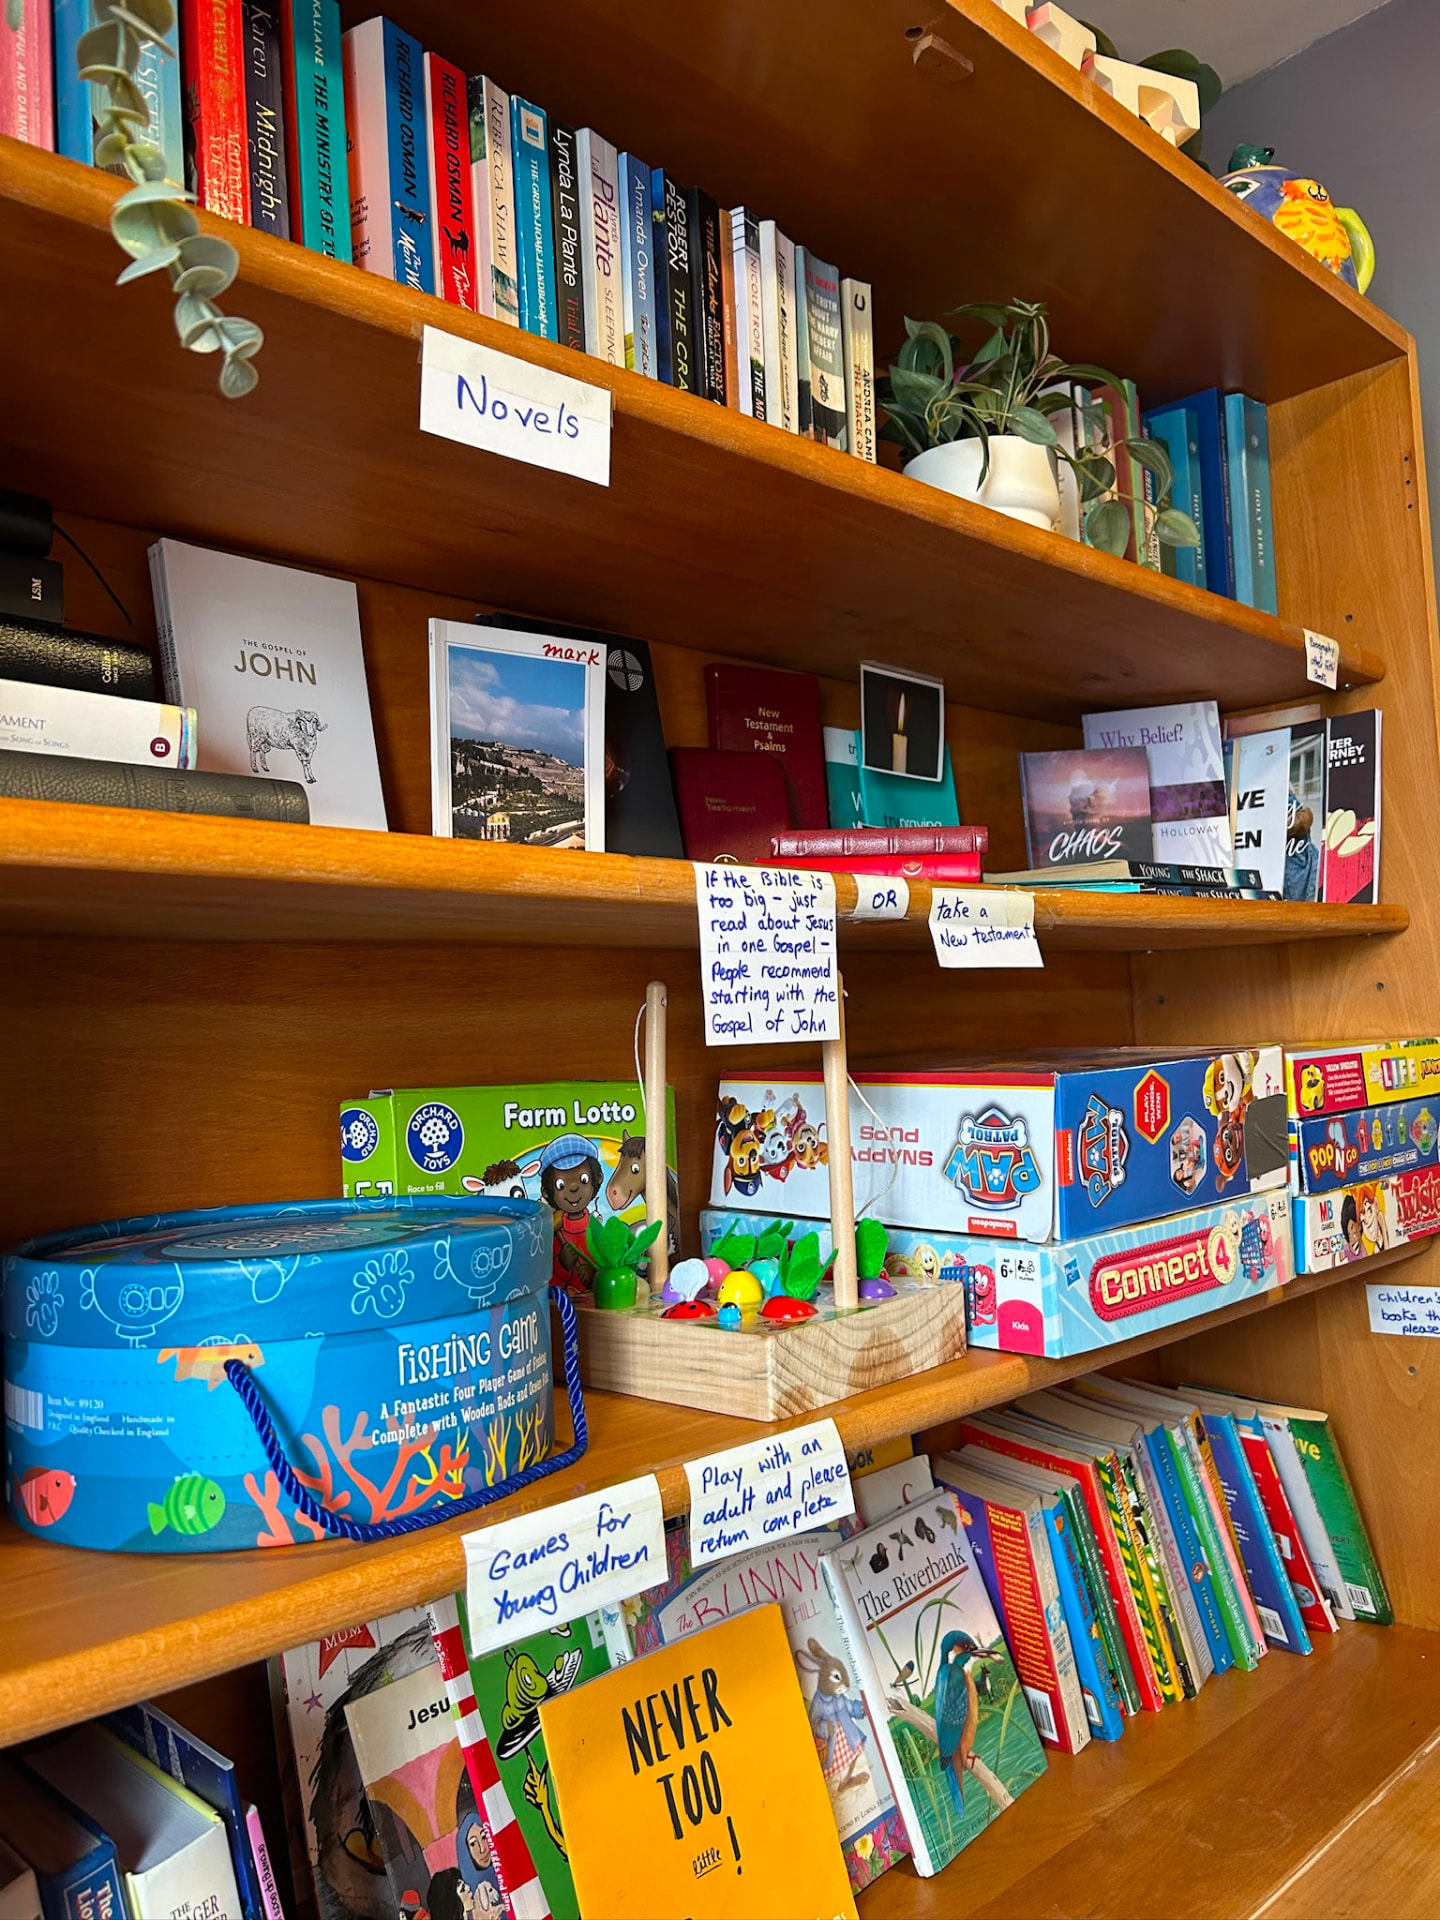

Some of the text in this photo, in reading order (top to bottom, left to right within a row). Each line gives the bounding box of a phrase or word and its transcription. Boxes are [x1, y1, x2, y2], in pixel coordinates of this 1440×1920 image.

[251, 4, 272, 78] Karen
[253, 100, 282, 221] Midnight
[313, 73, 335, 237] THE MINISTRY OF
[401, 126, 418, 198] OSMAN
[553, 128, 574, 189] Lynda
[446, 150, 464, 223] OSMAN
[491, 97, 508, 266] REBECCA SHAW
[560, 191, 576, 220] La
[592, 171, 616, 278] Plante
[633, 175, 649, 300] Amanda Owen
[665, 178, 679, 271] PESTON
[676, 194, 689, 274] ROBERT
[397, 226, 416, 265] Man
[561, 223, 579, 288] Plante
[567, 297, 582, 335] Trial
[674, 288, 687, 337] THE
[750, 257, 761, 355] NICOLE TROPE
[816, 294, 838, 313] TRUTH
[604, 286, 617, 365] SLEEPING
[713, 318, 724, 396] FACTORY
[457, 374, 580, 439] Novels
[863, 368, 873, 462] ANDREA CAMI
[1255, 489, 1265, 567] HOLY BIBLE
[31, 577, 42, 601] LSM
[242, 638, 307, 657] THE GOSPEL OF
[542, 642, 600, 666] mark
[102, 649, 112, 684] Collins
[233, 649, 318, 686] JOHN
[744, 717, 794, 734] Testament
[758, 707, 780, 719] New
[754, 739, 786, 752] Psalms
[1100, 723, 1184, 749] Why Belief?
[1265, 745, 1275, 756] 3
[1048, 825, 1124, 862] CHAOS
[1160, 824, 1220, 838] HOLLOWAY
[705, 868, 824, 890] If the Bible is
[1139, 863, 1225, 884] YOUNG THE SHACK
[709, 893, 734, 909] too
[743, 890, 767, 915] big
[787, 892, 818, 915] just
[871, 891, 898, 909] OR
[936, 896, 989, 920] take a
[710, 914, 835, 932] read about Jesus
[940, 929, 968, 948] New
[717, 935, 730, 952] in
[740, 939, 768, 952] one
[773, 932, 816, 962] Gospel
[711, 957, 831, 988] People recommend
[709, 981, 837, 1011] starting with the
[711, 1008, 827, 1037] Gospel of John
[1382, 1058, 1418, 1087] LIFE
[411, 1106, 459, 1132] ORCHARD
[503, 1099, 636, 1129] Farm Lotto
[359, 1112, 377, 1157] ORCHARD
[859, 1125, 919, 1143] PUPS
[967, 1126, 1020, 1143] PATROL
[1085, 1094, 1112, 1209] PAW
[1111, 1118, 1121, 1177] PATROL
[423, 1155, 451, 1170] TOYS
[942, 1143, 1044, 1195] PAW
[1309, 1143, 1357, 1175] POP N GO
[407, 1181, 445, 1194] Race to fill
[970, 1218, 1014, 1230] nickelodeon
[1319, 1200, 1334, 1223] MB
[1321, 1222, 1335, 1231] GAMES
[1101, 1236, 1232, 1306] Connect 4
[1378, 1290, 1440, 1304] Children's
[1381, 1307, 1417, 1322] books
[498, 1308, 540, 1357] Game
[1011, 1320, 1030, 1332] Kids
[1402, 1322, 1440, 1335] please
[380, 1402, 390, 1420] A
[394, 1392, 450, 1417] Fantastic
[453, 1384, 476, 1403] Four
[478, 1375, 505, 1395] Player
[507, 1366, 525, 1383] Game
[526, 1363, 532, 1377] of
[371, 1424, 429, 1446] Complete
[431, 1411, 458, 1433] with
[460, 1401, 495, 1424] Wooden
[497, 1390, 516, 1411] Rods
[516, 1384, 528, 1403] and
[528, 1377, 542, 1395] Ocean
[69, 1423, 169, 1438] Quality Checked in England
[702, 1437, 823, 1494] Play with an
[702, 1462, 848, 1525] adult and please
[489, 1503, 632, 1581] Games for
[699, 1497, 838, 1555] return complete
[1160, 1444, 1221, 1640] FRENCH REVOLUTIONS TIM MOORE
[494, 1543, 649, 1624] Young Children
[858, 1541, 968, 1621] The Riverbank
[677, 1614, 694, 1633] The
[792, 1599, 822, 1625] HILL
[323, 1624, 364, 1652] MUM
[837, 1614, 863, 1687] The Riverbank
[407, 1696, 452, 1731] Jesu
[621, 1668, 733, 1776] NEVER
[657, 1751, 724, 1841] TOO
[692, 1815, 744, 1877] little !
[482, 1821, 511, 1913] Green Eggs and Ham
[96, 1880, 114, 1920] The
[170, 1900, 191, 1920] THE
